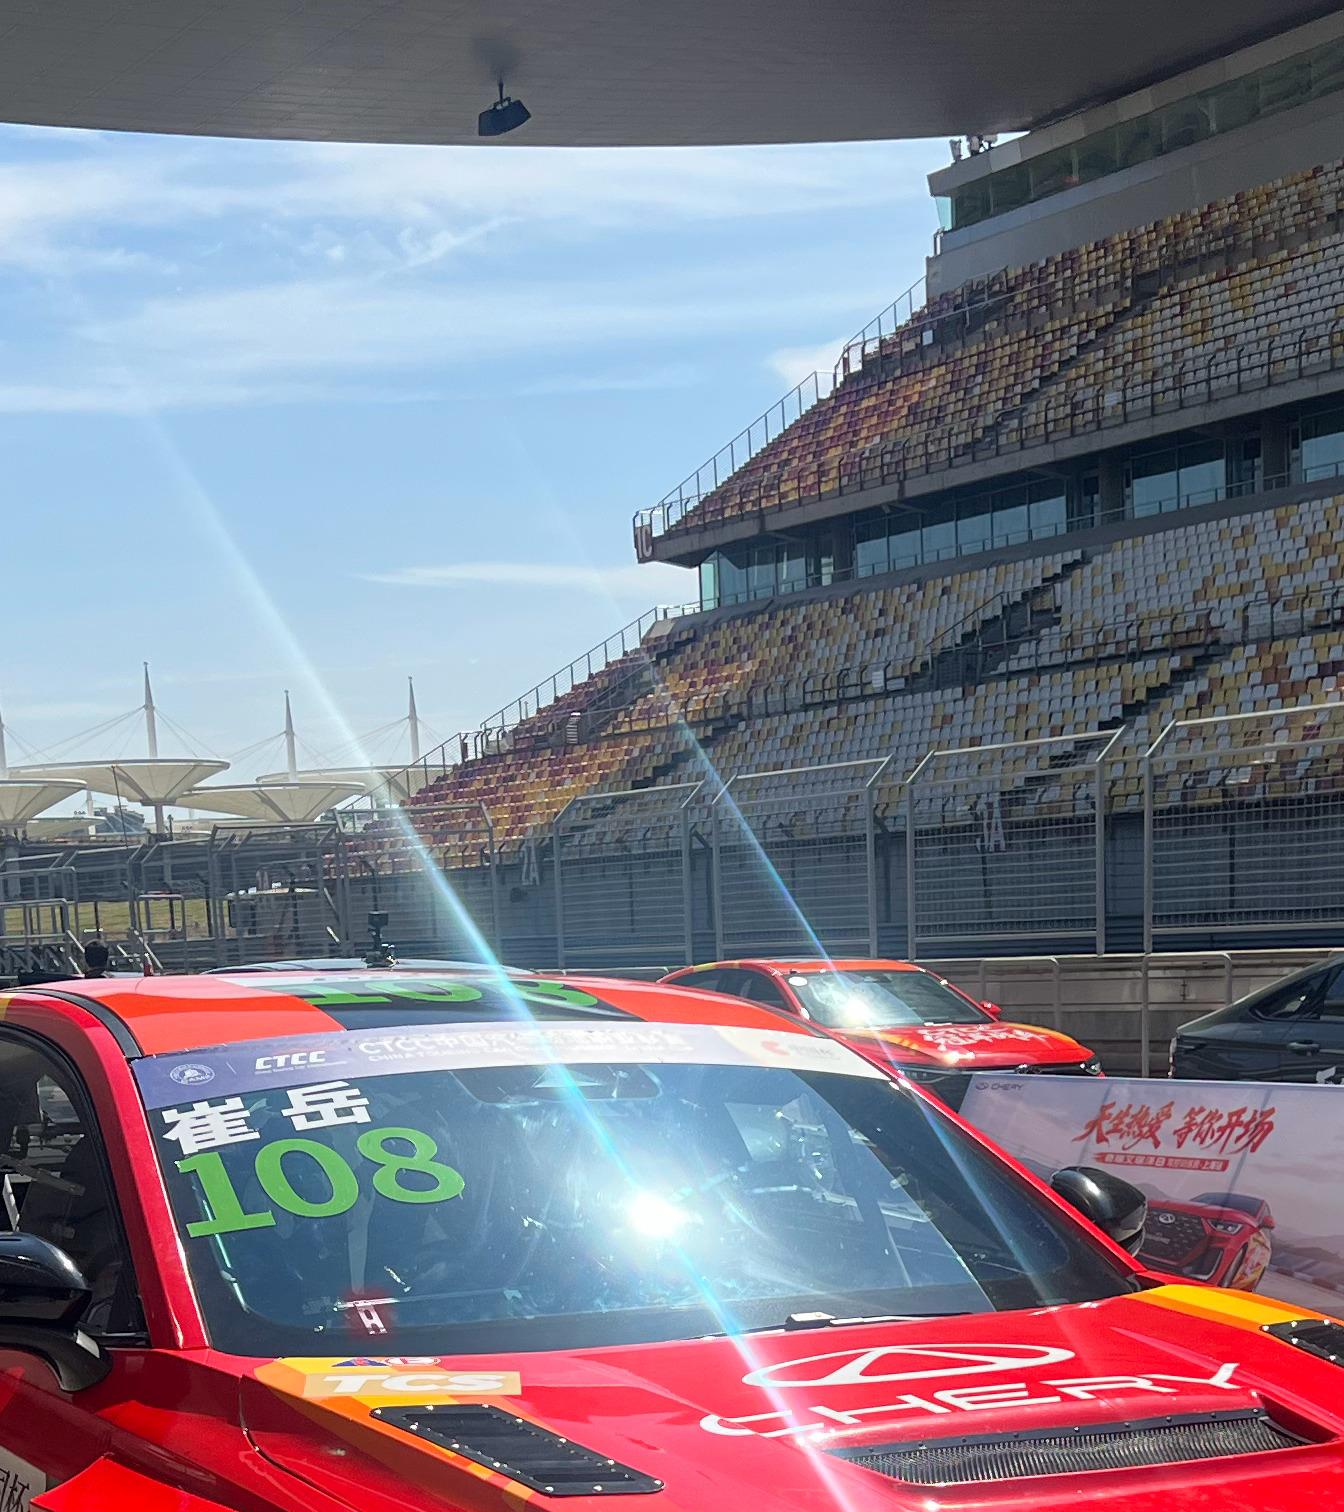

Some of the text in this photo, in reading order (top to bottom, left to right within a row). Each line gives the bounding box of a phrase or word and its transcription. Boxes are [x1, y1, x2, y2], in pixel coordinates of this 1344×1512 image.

[255, 1049, 327, 1071] CTCC
[161, 1080, 372, 1155] 崔岳
[1173, 1106, 1276, 1156] 等你开场
[174, 1126, 465, 1239] 108
[323, 1374, 507, 1393] TCS
[699, 1362, 1241, 1438] CHERY
